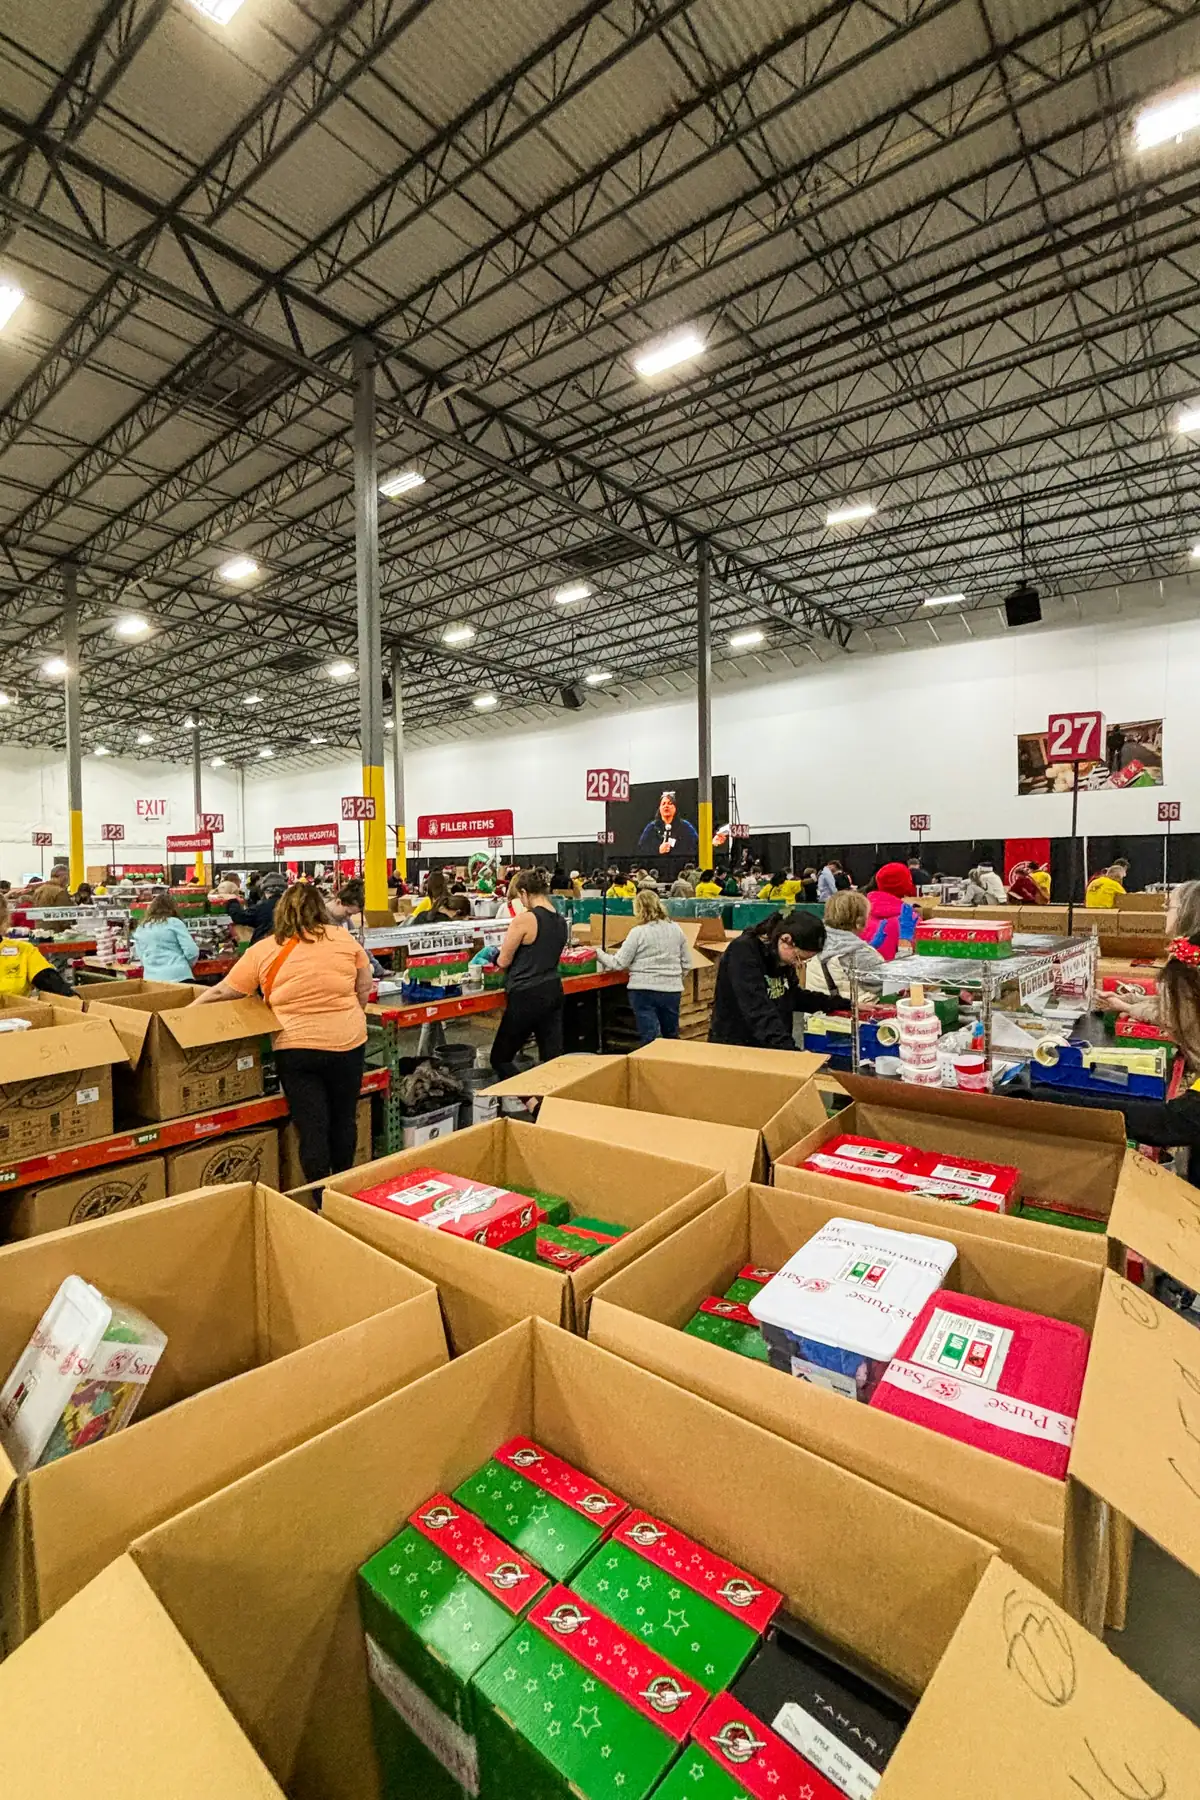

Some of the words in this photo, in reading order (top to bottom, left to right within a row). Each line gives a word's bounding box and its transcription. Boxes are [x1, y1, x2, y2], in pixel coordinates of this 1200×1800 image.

[1051, 716, 1097, 756] 27
[587, 772, 610, 798] 26
[612, 772, 629, 799] 26
[136, 799, 166, 815] EXIT
[342, 799, 354, 818] 25
[356, 799, 375, 818] 25
[1159, 803, 1179, 819] 36
[206, 814, 223, 831] 24
[440, 820, 467, 832] FILLER
[469, 819, 494, 830] ITEMS
[731, 824, 742, 837] 34
[911, 815, 926, 829] 35
[38, 834, 52, 845] 22
[109, 825, 124, 839] 23
[282, 832, 308, 842] SHOEBOX
[309, 829, 337, 840] HOSPITAL
[987, 1397, 1049, 1431] Purse
[814, 1692, 884, 1756] TAHARI
[813, 1735, 830, 1752] STYLE
[833, 1752, 853, 1771] COLOR
[827, 1765, 848, 1786] CREAM
